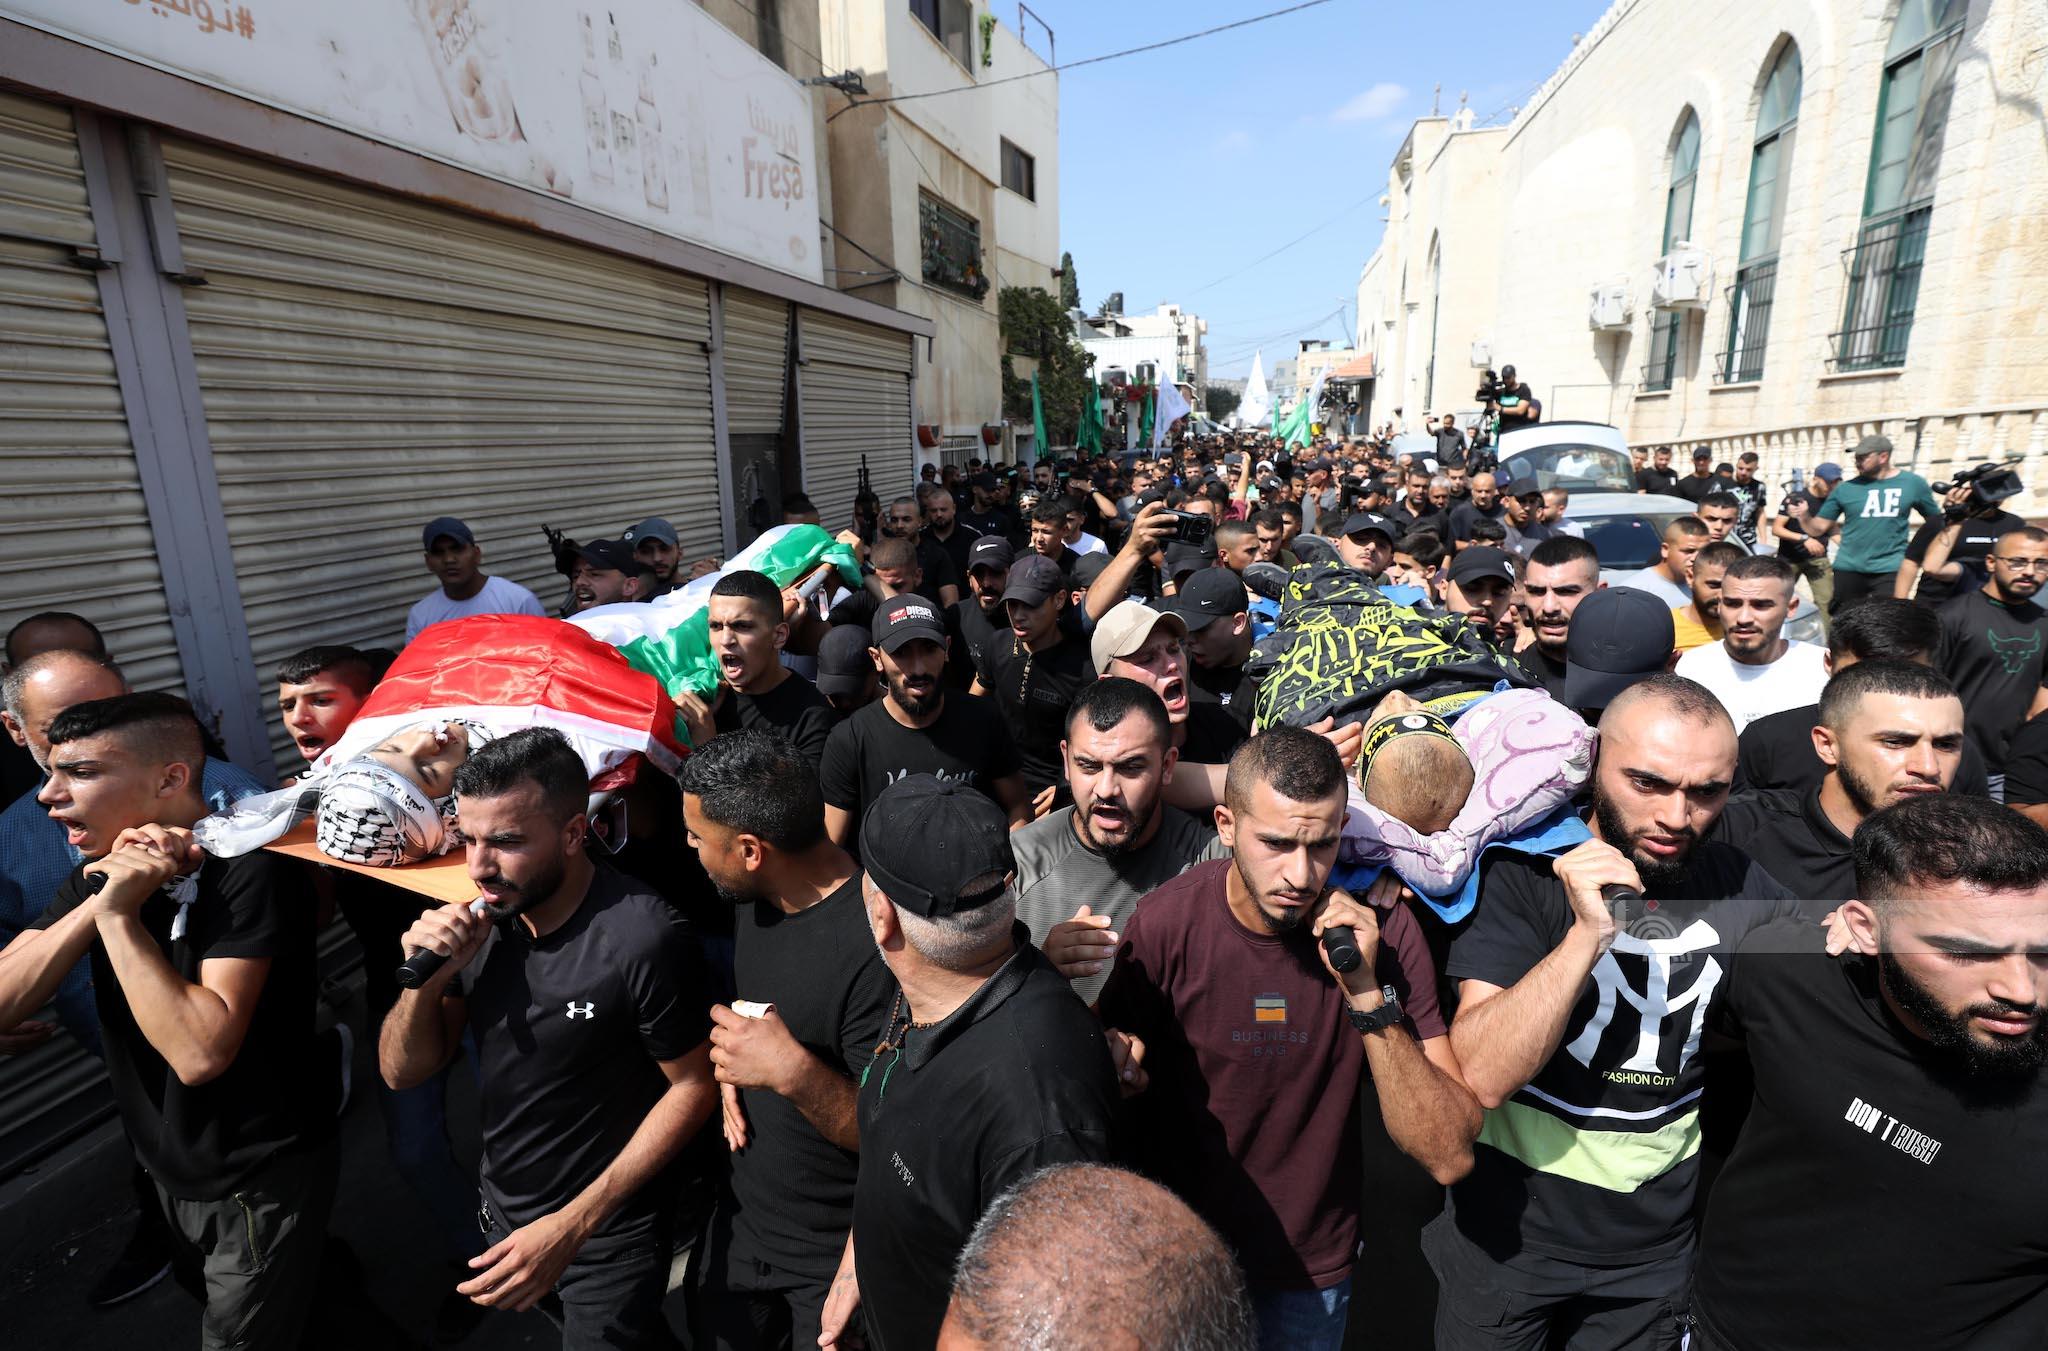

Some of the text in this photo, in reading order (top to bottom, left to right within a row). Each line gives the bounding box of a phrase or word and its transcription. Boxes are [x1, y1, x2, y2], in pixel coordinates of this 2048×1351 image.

[1860, 488, 1902, 518] AE
[905, 605, 933, 617] DIESEL
[1232, 1031, 1308, 1043] BUSINESS
[1254, 1046, 1286, 1056] BAG
[1602, 1070, 1677, 1086] FASHION CITY
[1891, 1123, 1942, 1165] RUSH
